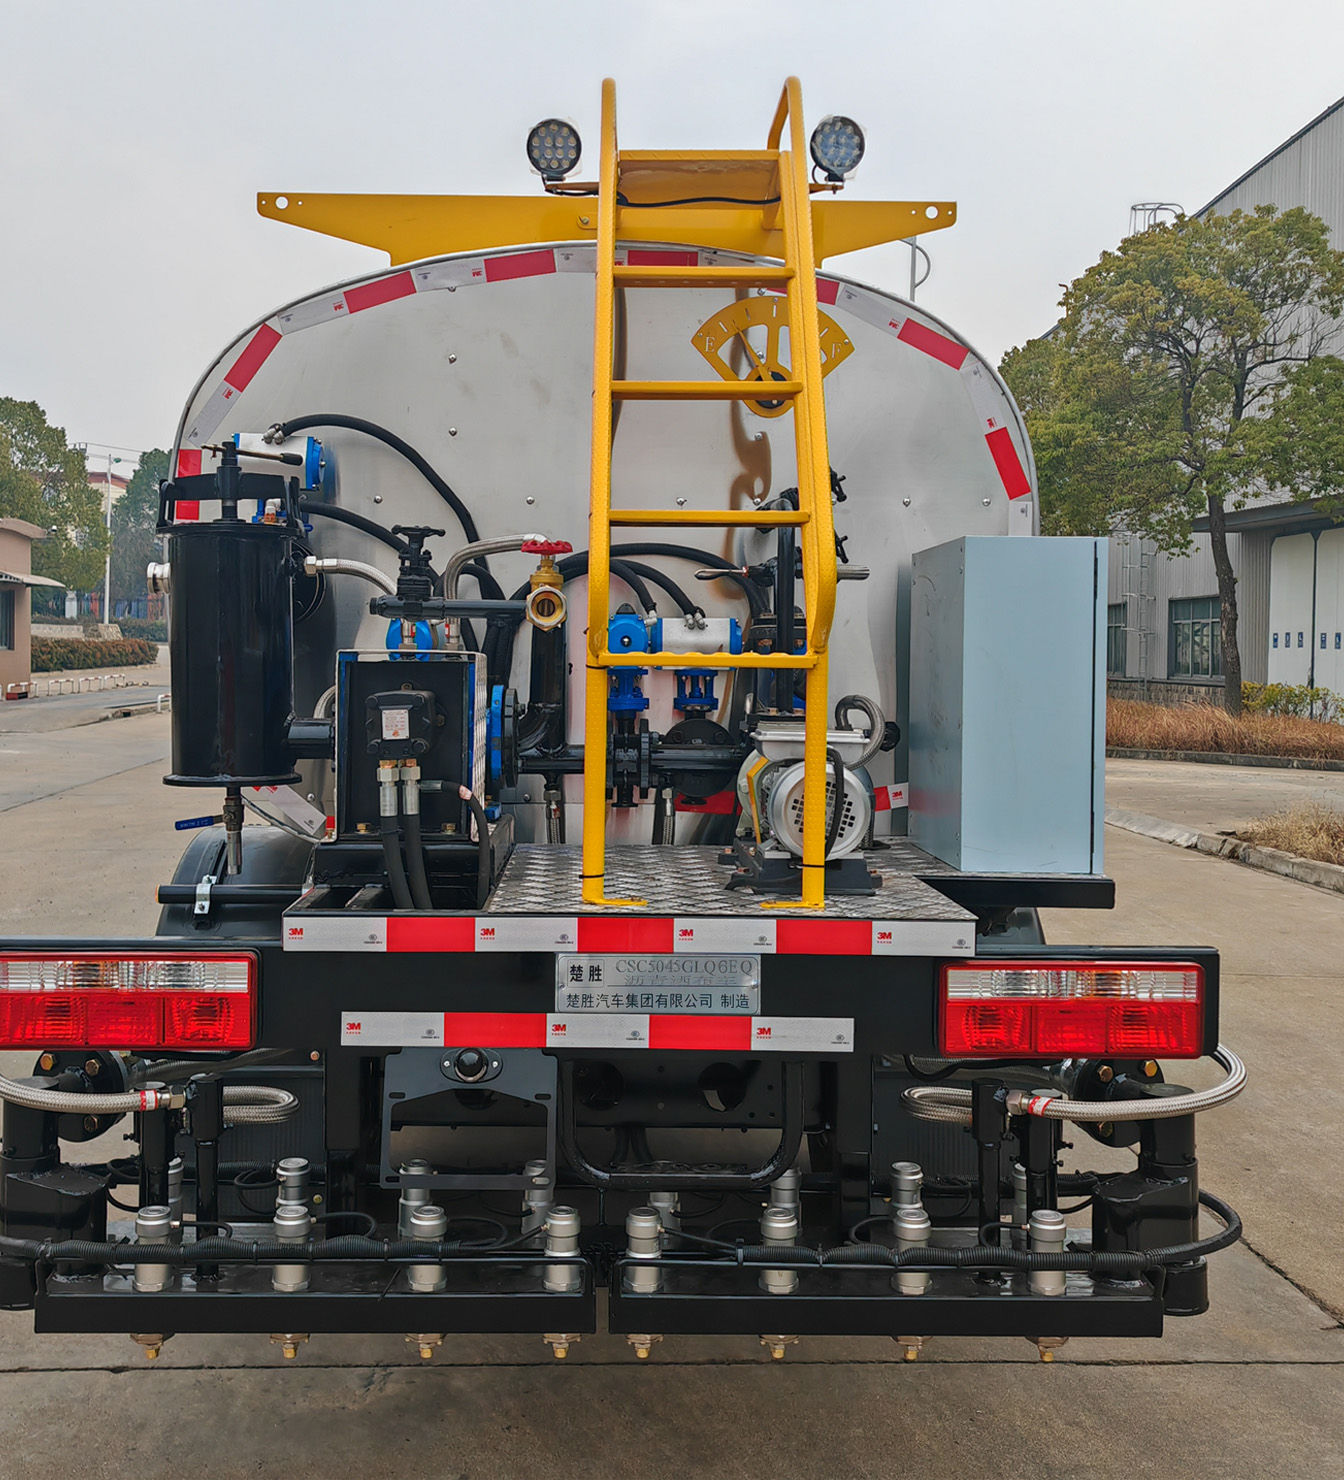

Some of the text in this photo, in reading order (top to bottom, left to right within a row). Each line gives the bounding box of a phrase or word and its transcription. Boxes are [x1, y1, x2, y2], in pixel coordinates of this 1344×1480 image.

[705, 336, 715, 353] E
[831, 343, 841, 358] F
[289, 928, 303, 936] 3M
[480, 928, 495, 936] 3M
[679, 929, 694, 937] 3M
[877, 932, 892, 940] 3M
[569, 964, 603, 982] 楚胜
[566, 993, 750, 1009] 楚胜汽车集团有限公司 制造
[346, 1023, 361, 1031] 3M
[551, 1024, 566, 1032] 3M
[756, 1027, 771, 1036] 3M
